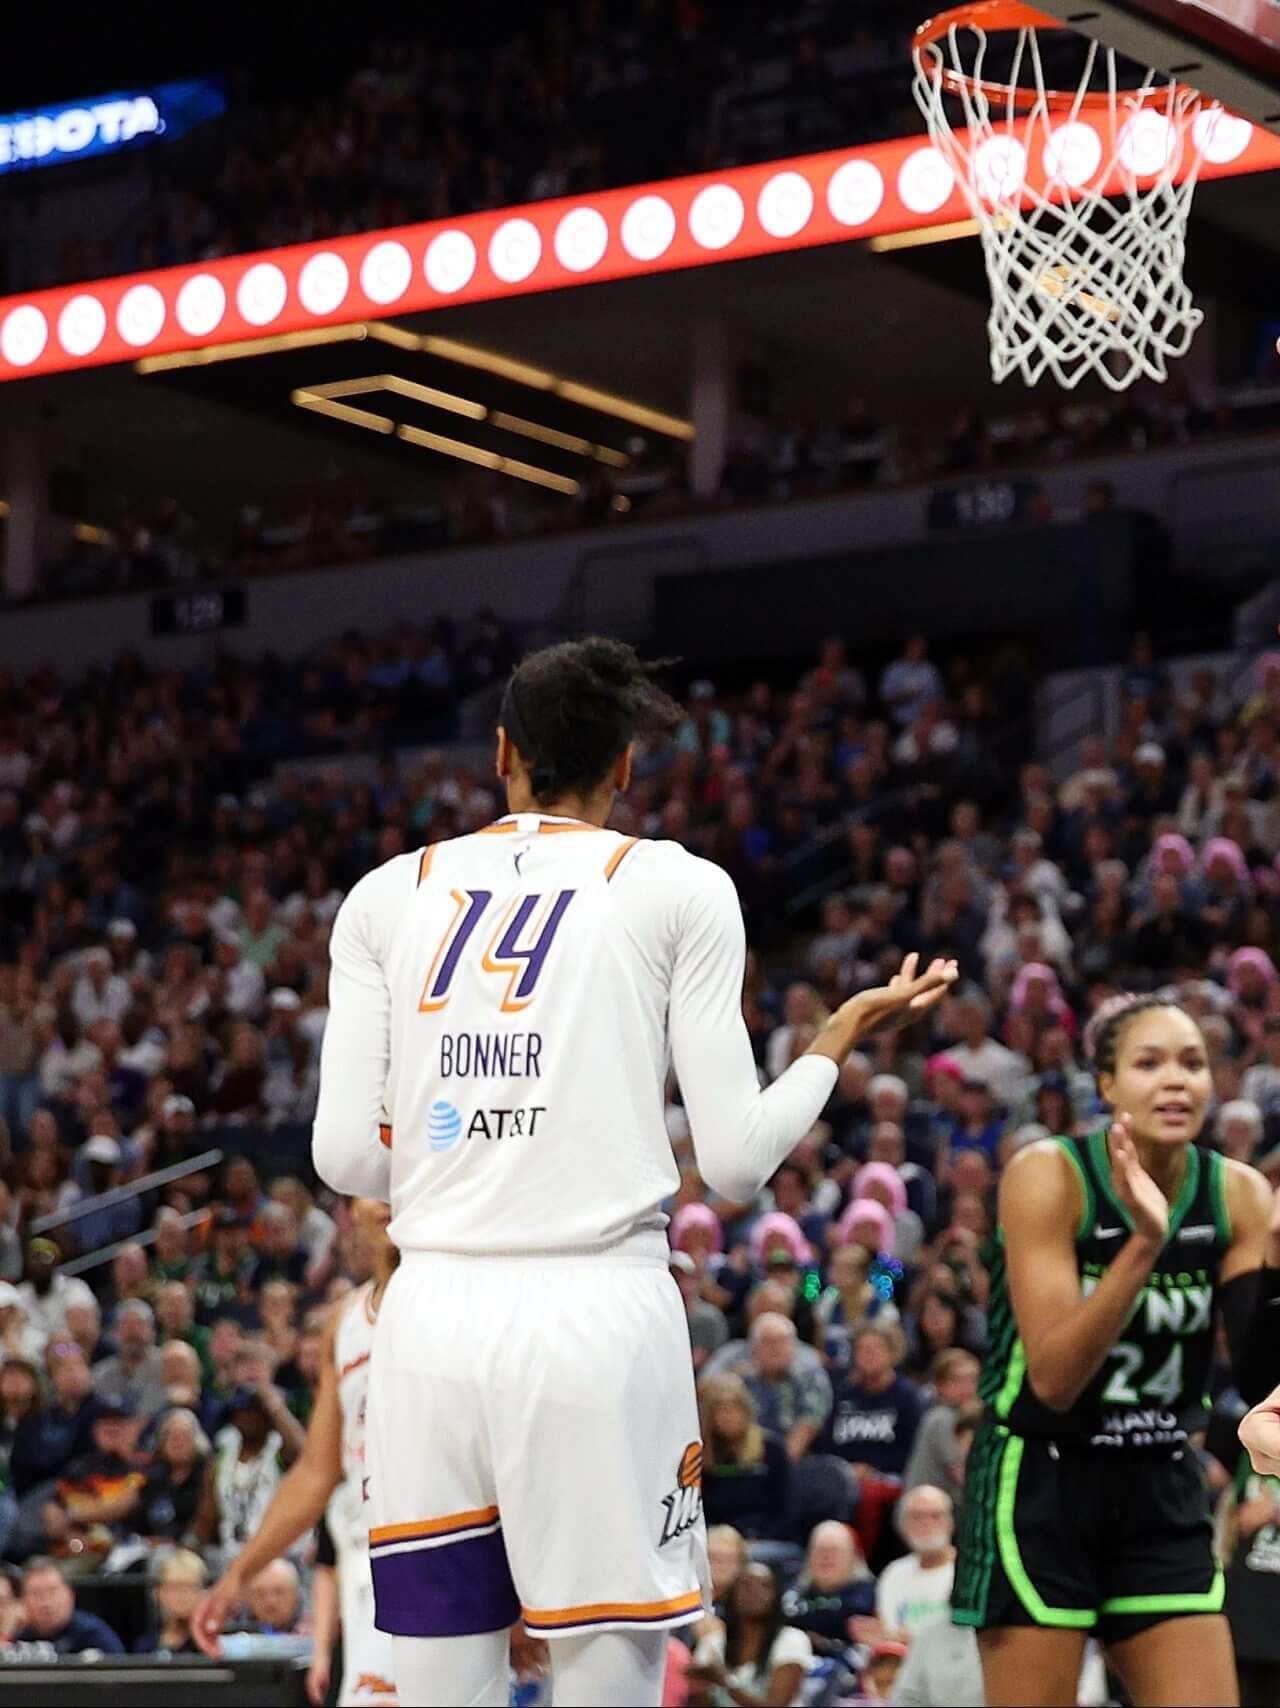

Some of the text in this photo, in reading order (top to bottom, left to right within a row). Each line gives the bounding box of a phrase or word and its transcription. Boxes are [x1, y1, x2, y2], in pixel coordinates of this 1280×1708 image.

[418, 888, 577, 1013] 14
[440, 1033, 542, 1078] BONNER
[467, 1107, 546, 1140] AT&T
[1102, 1342, 1183, 1405] 24
